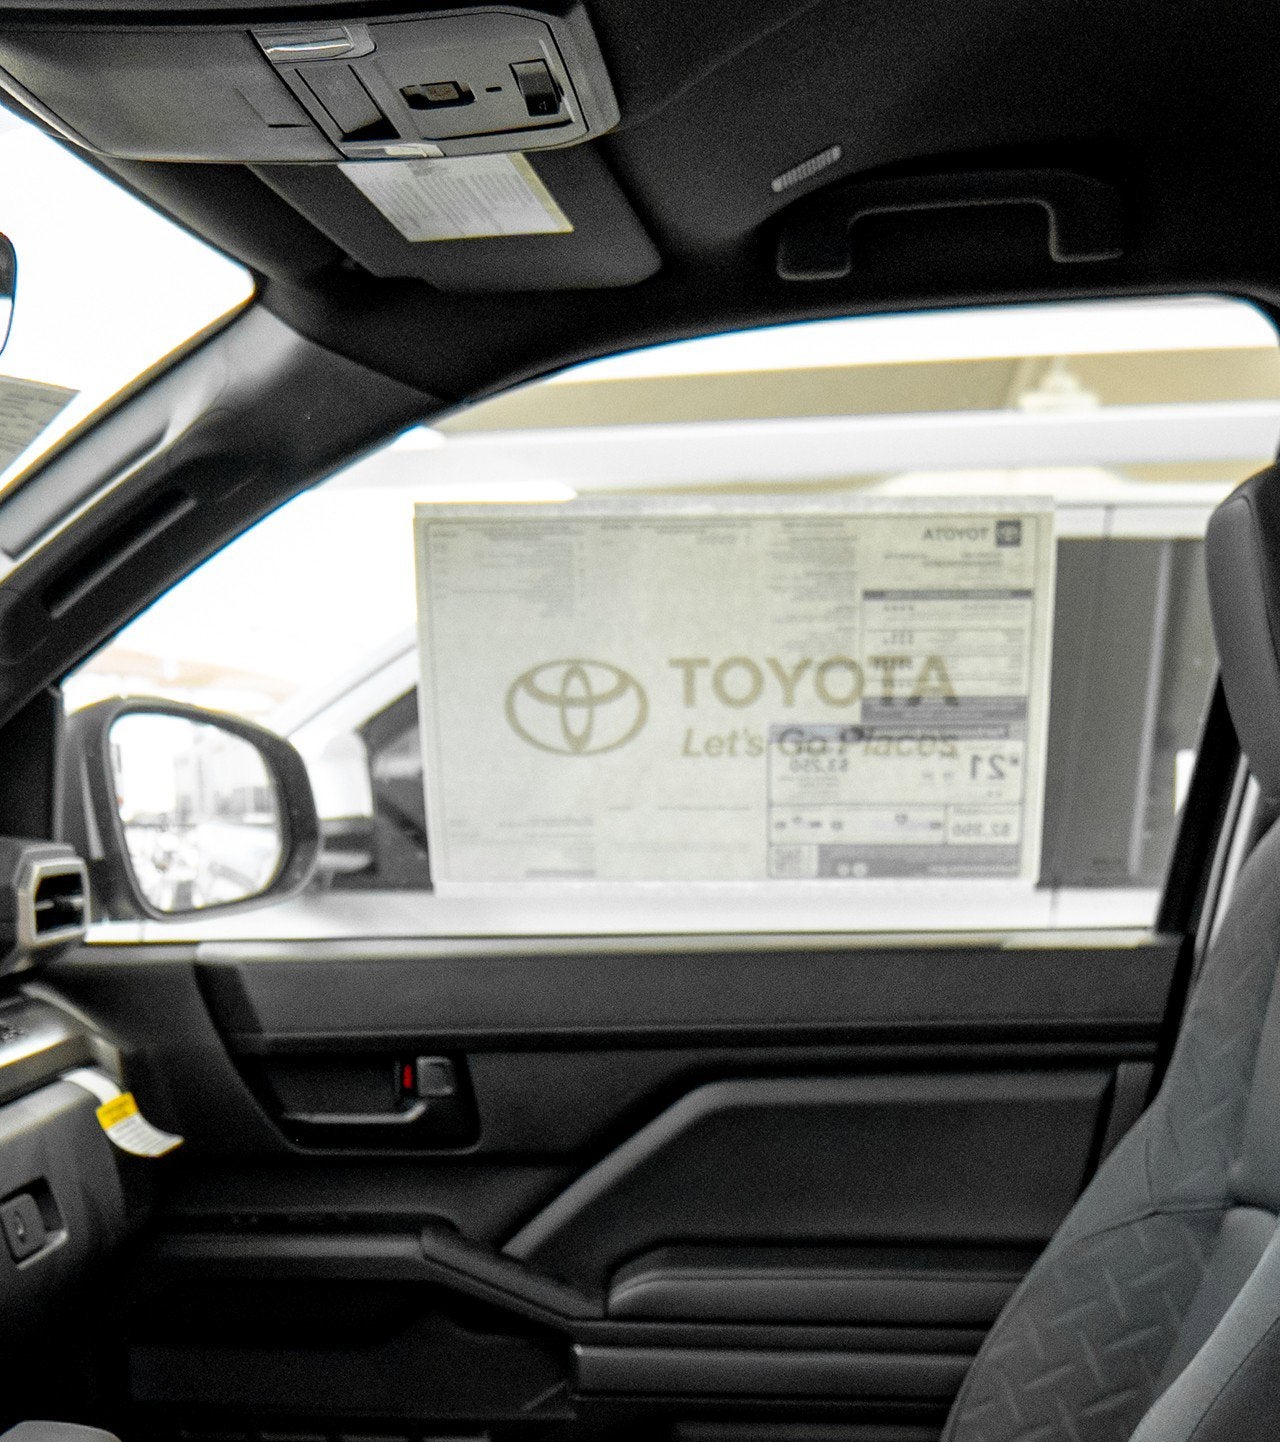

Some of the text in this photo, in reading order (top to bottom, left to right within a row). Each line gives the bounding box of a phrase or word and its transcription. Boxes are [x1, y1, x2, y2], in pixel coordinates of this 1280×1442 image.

[668, 654, 960, 709] TOYOTA
[681, 727, 764, 758] Let's
[778, 727, 829, 758] Go
